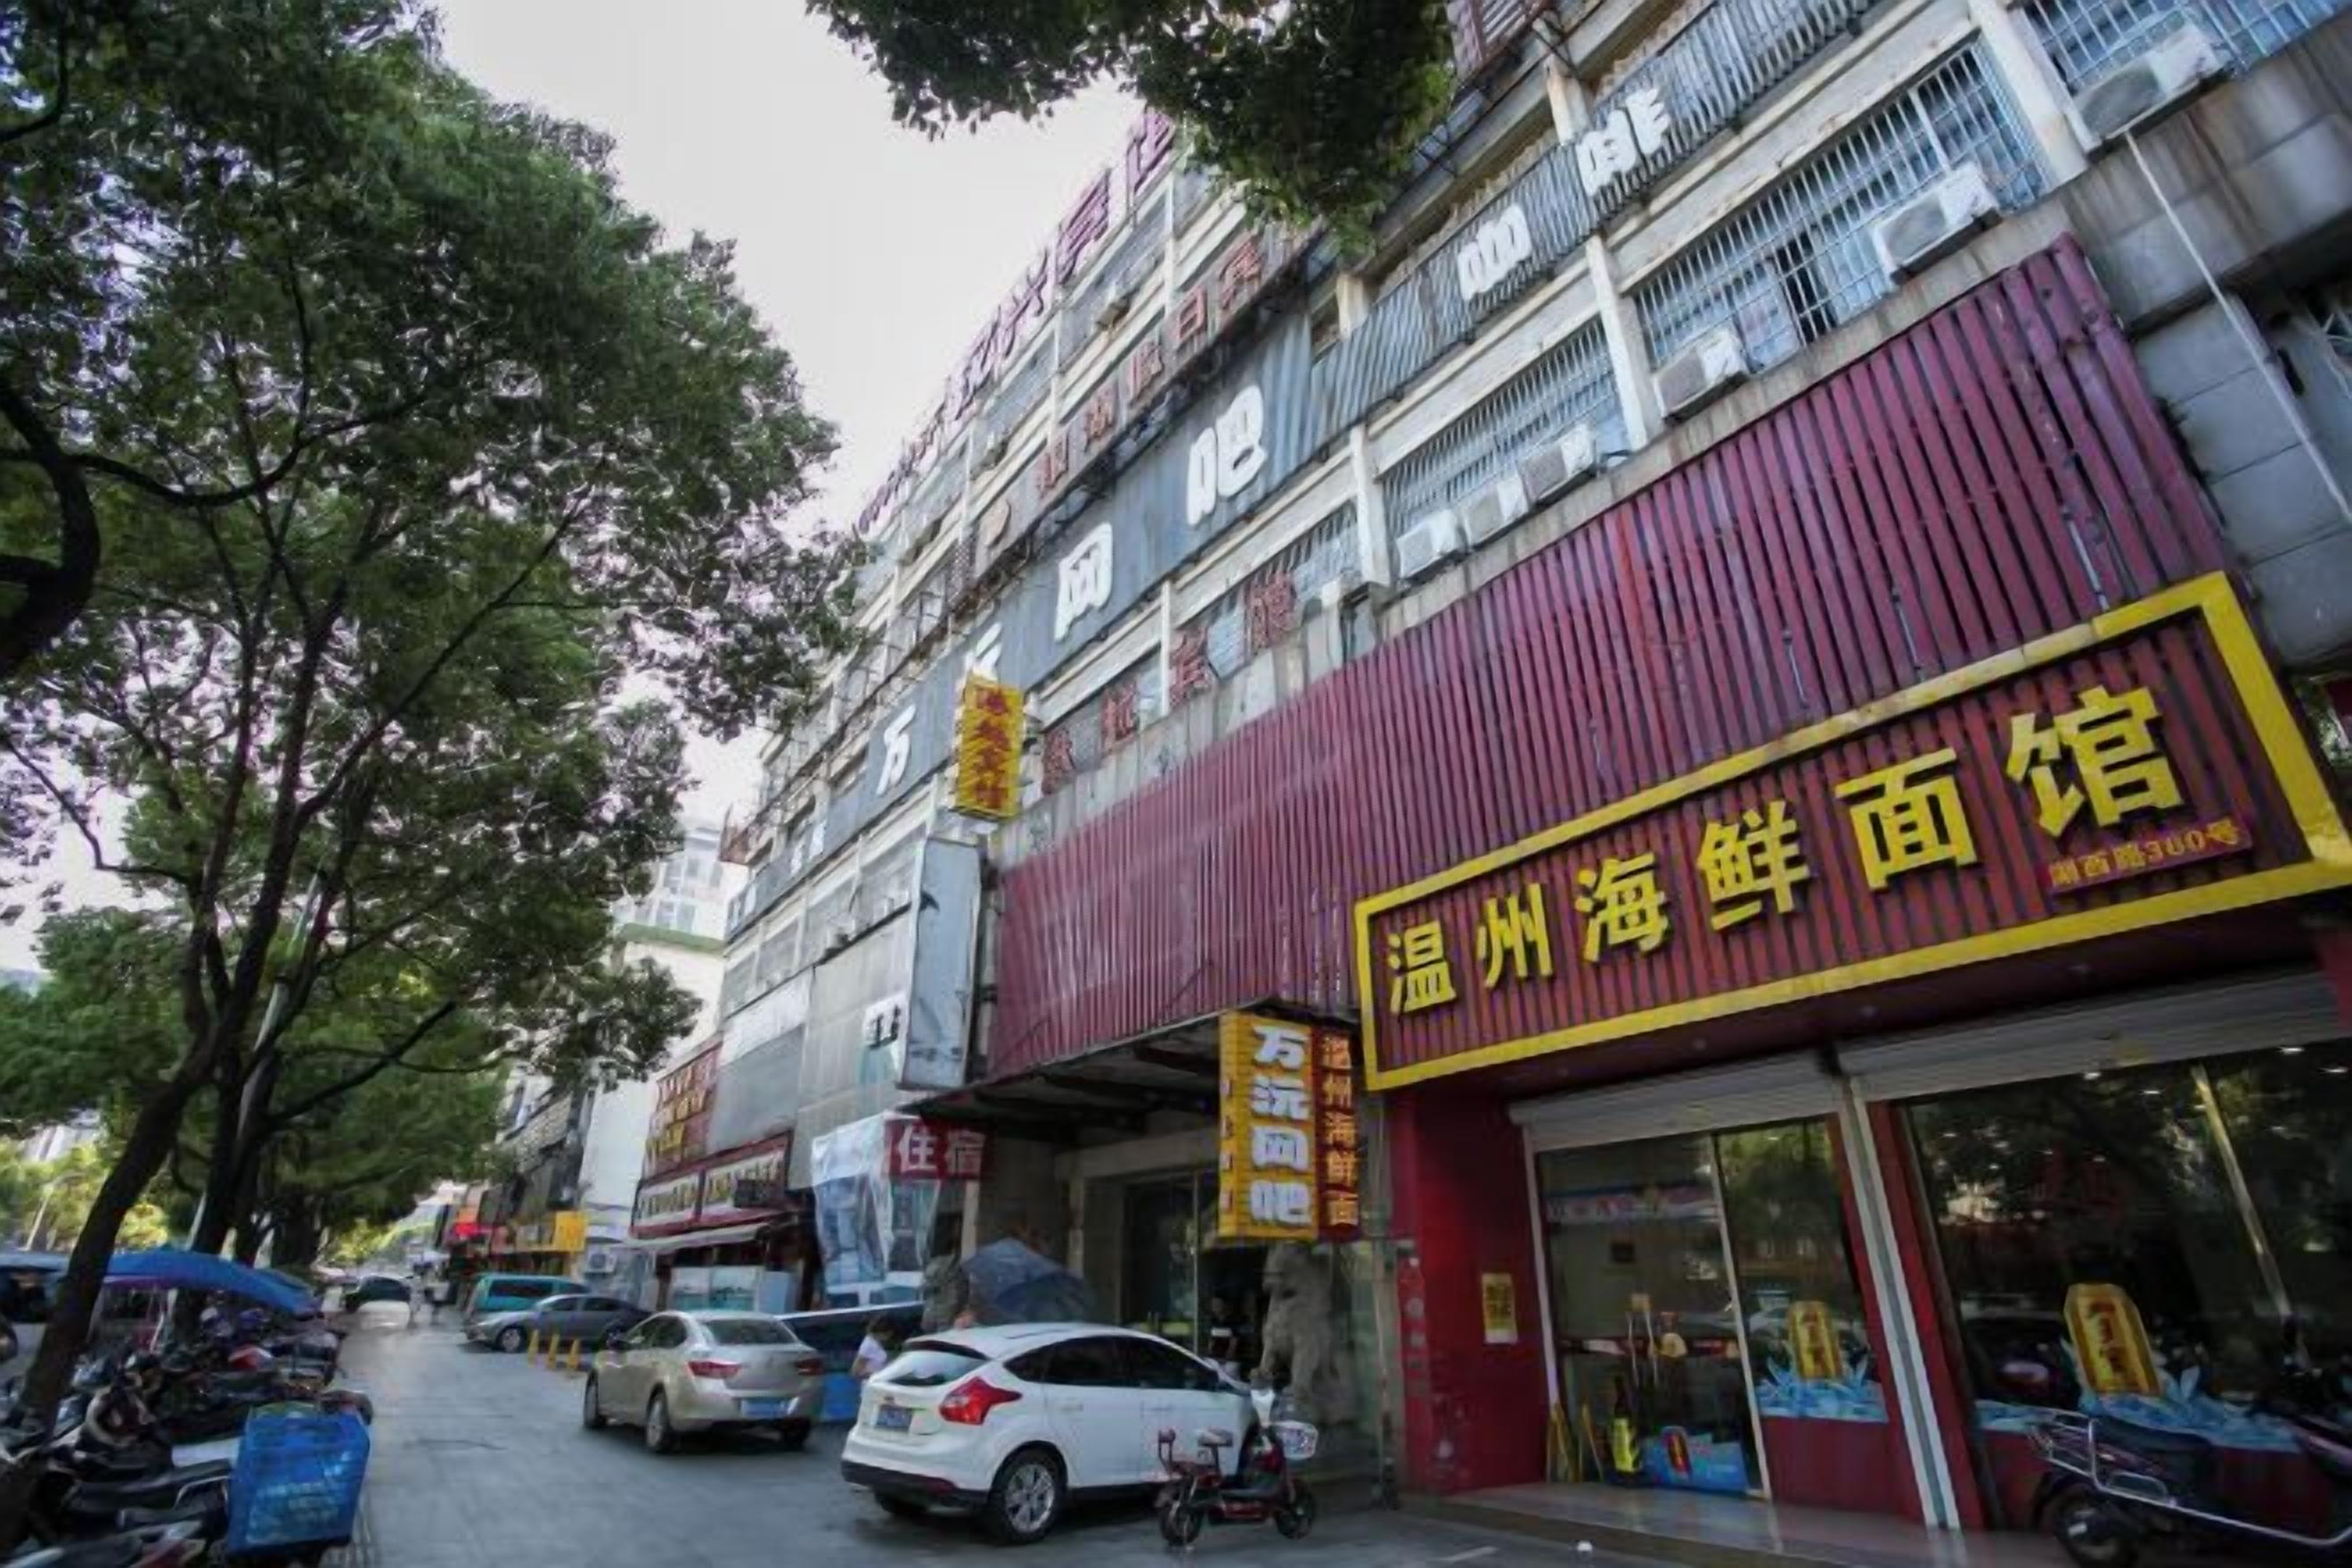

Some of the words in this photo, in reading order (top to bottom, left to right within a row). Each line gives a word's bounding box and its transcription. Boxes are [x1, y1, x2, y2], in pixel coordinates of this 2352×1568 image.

[1458, 86, 1671, 301] 咖啡
[1386, 685, 2186, 1016] 温州海鲜面馆
[897, 1123, 987, 1176] 住宿
